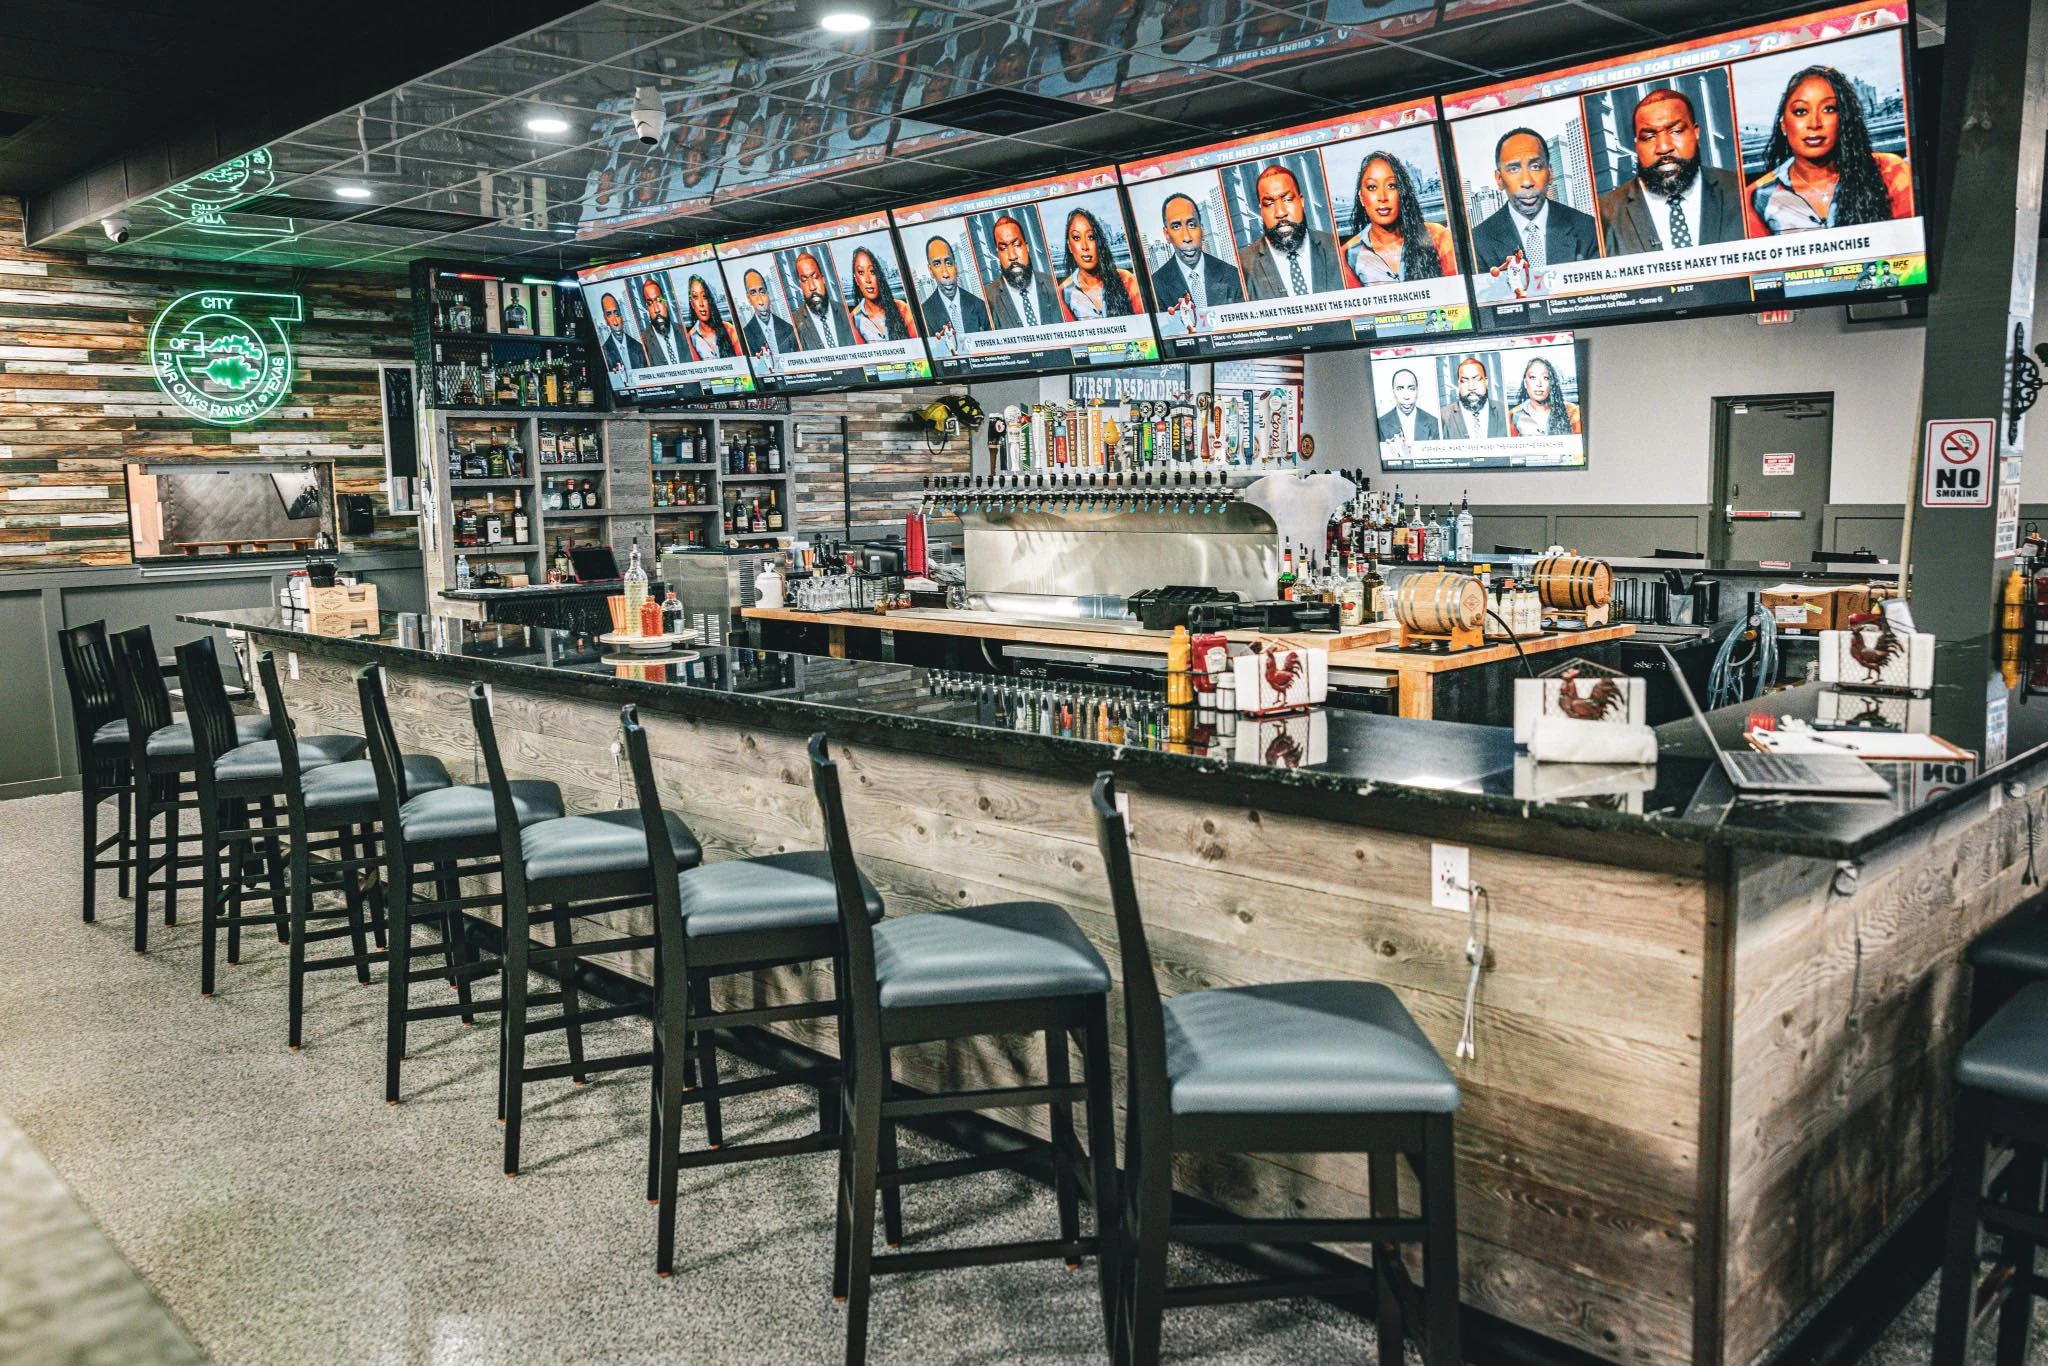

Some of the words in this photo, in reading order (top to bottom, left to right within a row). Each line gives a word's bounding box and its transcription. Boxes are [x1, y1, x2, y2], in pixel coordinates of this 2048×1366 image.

[1581, 73, 1605, 87] THE
[1607, 65, 1641, 82] NEED
[1644, 59, 1670, 75] FOR
[1217, 150, 1234, 162] THE
[1234, 145, 1258, 158] NEED
[1259, 141, 1278, 153] FOR
[1562, 270, 1602, 284] STEPHEN
[1619, 265, 1644, 277] MAKE
[1646, 260, 1681, 274] TYRESE
[1683, 255, 1717, 269] MAXEY
[1720, 253, 1739, 265] THE
[1742, 249, 1766, 262] FACE
[1769, 247, 1783, 259] OF
[1786, 244, 1805, 257] THE
[1808, 236, 1870, 254] FRANCHISE
[1892, 259, 1909, 267] UFC
[201, 296, 233, 310] CITY
[1220, 311, 1248, 322] STEPHEN
[1259, 308, 1277, 318] MAKE
[1278, 304, 1303, 316] TYRESE
[1304, 302, 1327, 313] MAXEY
[1328, 300, 1342, 310] THE
[1343, 298, 1360, 308] FACE
[1361, 296, 1372, 306] OF
[1373, 294, 1387, 305] THE
[1388, 289, 1430, 303] FRANCHISE
[1496, 303, 1523, 314] ESPN
[1549, 298, 1566, 306] Stars
[1577, 294, 1600, 303] Golden
[1600, 291, 1627, 301] Knights
[1551, 305, 1574, 314] Western
[1574, 302, 1606, 312] Conference
[1616, 298, 1636, 307] Round
[1638, 296, 1656, 305] Game
[1657, 295, 1663, 303] 6
[1763, 311, 1788, 323] EXIT
[169, 338, 190, 350] OF
[974, 338, 996, 347] STEPHEN
[1003, 336, 1016, 344] MAKE
[1016, 334, 1035, 343] TYRESE
[1035, 332, 1053, 341] MAXEY
[1053, 331, 1063, 339] THE
[1064, 330, 1077, 338] FACE
[1077, 329, 1085, 337] OF
[1084, 328, 1096, 336] THE
[1096, 325, 1127, 335] FRANCHISE
[158, 352, 178, 383] FAIR
[174, 383, 208, 412] OAKS
[209, 400, 260, 418] RANCH
[263, 357, 285, 398] TEXAS
[1075, 377, 1111, 400] FIRST
[1115, 378, 1185, 400] RESPONDERS
[1271, 411, 1281, 449] Coors
[1936, 468, 1980, 488] NO
[1936, 489, 1978, 497] SMOKING
